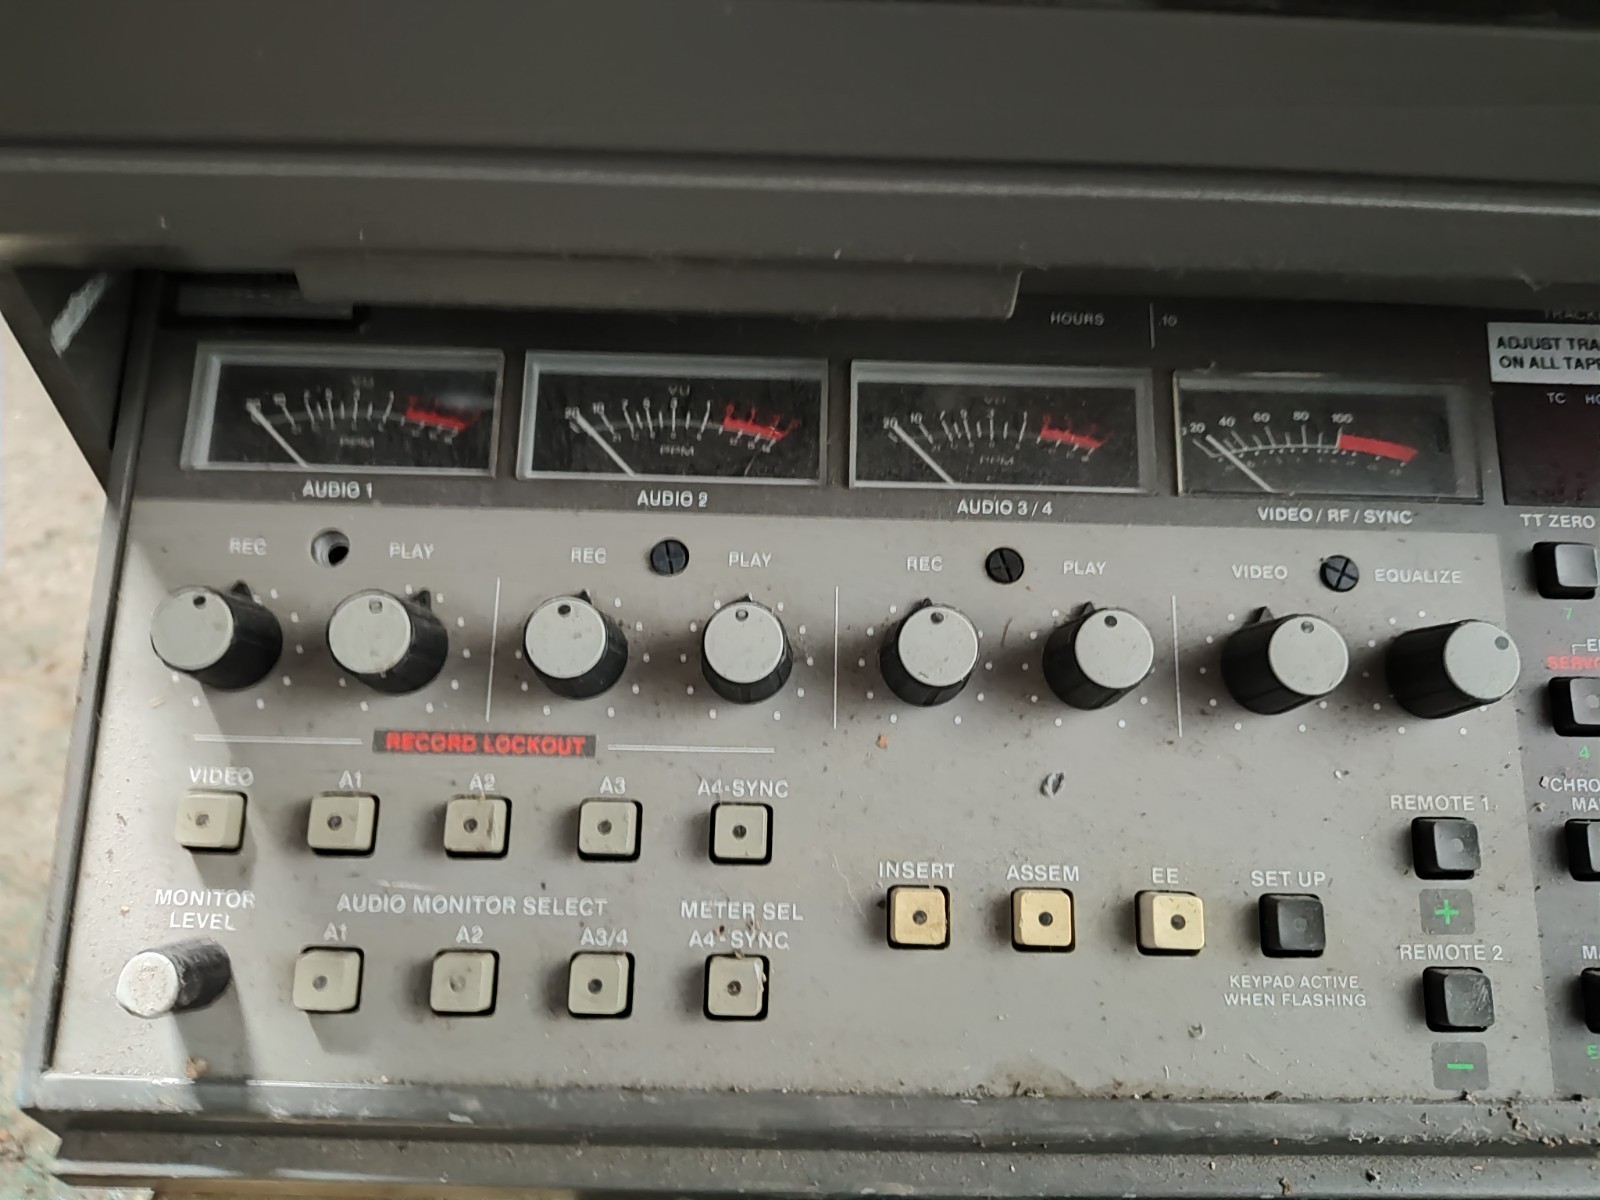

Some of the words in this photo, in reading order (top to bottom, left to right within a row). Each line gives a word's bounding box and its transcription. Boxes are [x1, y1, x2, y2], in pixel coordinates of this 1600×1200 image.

[1049, 312, 1104, 327] HOURS
[1497, 335, 1561, 350] ADJUST
[1499, 355, 1524, 369] ON
[1529, 356, 1561, 370] ALL
[1546, 392, 1567, 404] TC
[910, 412, 923, 425] 10
[1189, 422, 1206, 434] 20
[1218, 415, 1236, 428] 40
[1252, 411, 1271, 423] 60
[1331, 413, 1354, 424] 100
[302, 480, 360, 499] AUDIO
[365, 482, 374, 499] 1
[636, 490, 693, 507] AUDIO
[698, 492, 709, 508] 2
[956, 498, 1013, 516] AUDIO
[1017, 502, 1028, 516] 3
[1041, 501, 1053, 516] 4
[1257, 506, 1313, 522] VIDEO
[1327, 508, 1351, 523] RF
[1363, 509, 1414, 525] SYNC
[1519, 513, 1545, 527] TT
[1548, 514, 1596, 529] ZERO
[229, 537, 268, 556] REC
[388, 542, 435, 560] PLAY
[571, 547, 607, 564] REC
[728, 551, 773, 568] PLAY
[906, 556, 943, 572] REC
[1062, 560, 1107, 576] PLAY
[1231, 564, 1289, 581] VIDEO
[1374, 567, 1463, 584] EQUALIZE
[1563, 607, 1573, 620] 7
[384, 730, 477, 753] RECORD
[483, 734, 586, 755] LOCKOUT
[1578, 745, 1591, 760] 4
[189, 766, 255, 787] VIDEO
[338, 769, 363, 789] A1
[469, 772, 496, 792] A2
[600, 776, 626, 795] A3
[1390, 794, 1475, 811] REMOTE
[1482, 797, 1491, 811] 1
[878, 861, 956, 880] INSERT
[1006, 864, 1080, 882] ASSEM
[1152, 867, 1179, 884] EE
[1250, 870, 1292, 888] SET
[1298, 871, 1326, 888] UP
[154, 888, 256, 909] MONITOR
[337, 893, 406, 913] AUDIO
[412, 894, 517, 916] MONITOR
[522, 896, 609, 916] SELECT
[680, 900, 756, 920] METER
[763, 901, 804, 921] SEL
[169, 911, 237, 931] LEVEL
[323, 922, 348, 942] A1
[456, 925, 484, 944] A2
[580, 927, 629, 947] A3/4
[1399, 943, 1486, 961] REMOTE
[1492, 945, 1504, 961] 2
[1229, 974, 1295, 989] KEYPAD
[1299, 975, 1359, 989] ACTIVE
[1223, 993, 1275, 1007] WHEN
[1282, 993, 1367, 1007] FLASHING
